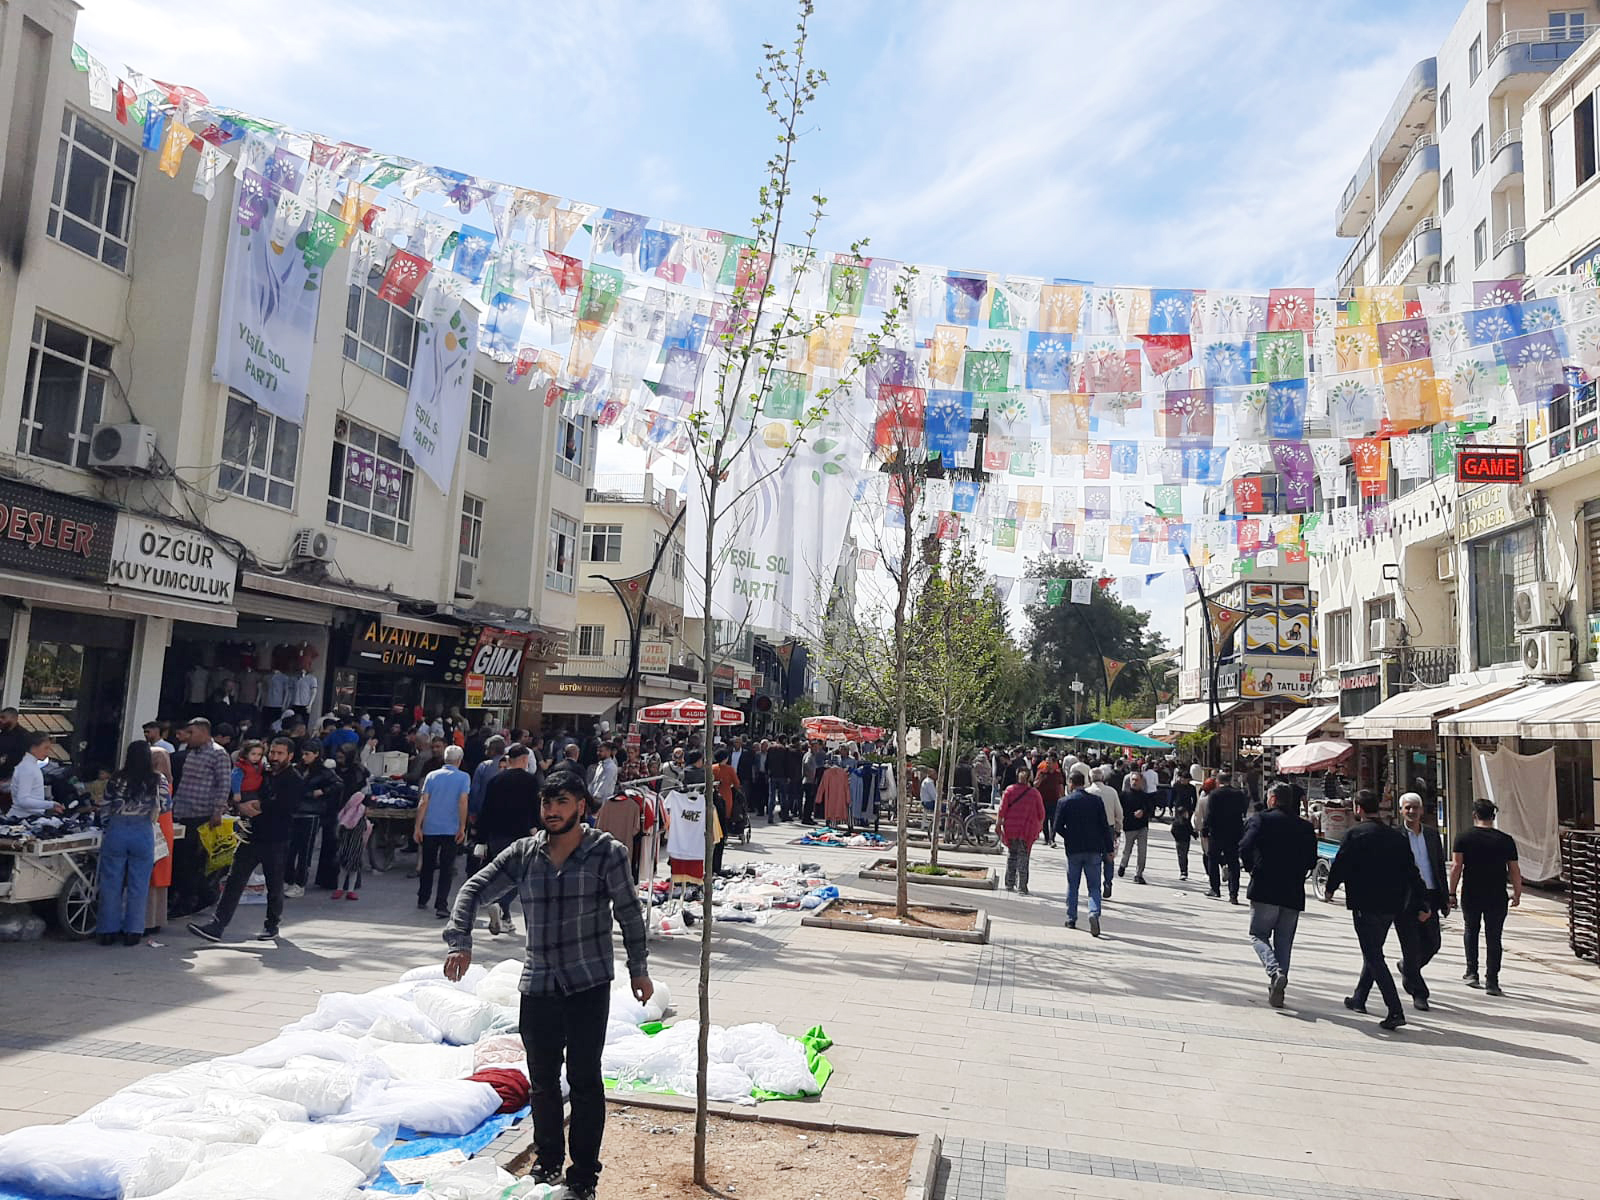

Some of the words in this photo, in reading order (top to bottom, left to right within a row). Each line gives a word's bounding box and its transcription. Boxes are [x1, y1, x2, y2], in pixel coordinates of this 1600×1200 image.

[239, 322, 267, 359] YEŞİL
[268, 348, 291, 374] SOL
[244, 356, 278, 392] PARTİ
[415, 402, 431, 430] EŞİL
[1464, 458, 1517, 476] GAME
[1459, 507, 1506, 538] DÖNER
[139, 524, 215, 569] ÖZGÜR
[719, 546, 761, 571] YEŞİL
[765, 554, 790, 575] SOL
[110, 560, 230, 598] KUYUMCULUK
[732, 577, 778, 601] PARTİ
[364, 621, 441, 651] AVANTAJ
[645, 645, 664, 654] OTEL
[382, 650, 417, 667] GİYİM
[473, 640, 523, 677] GİMA
[1277, 683, 1299, 691] TATLI
